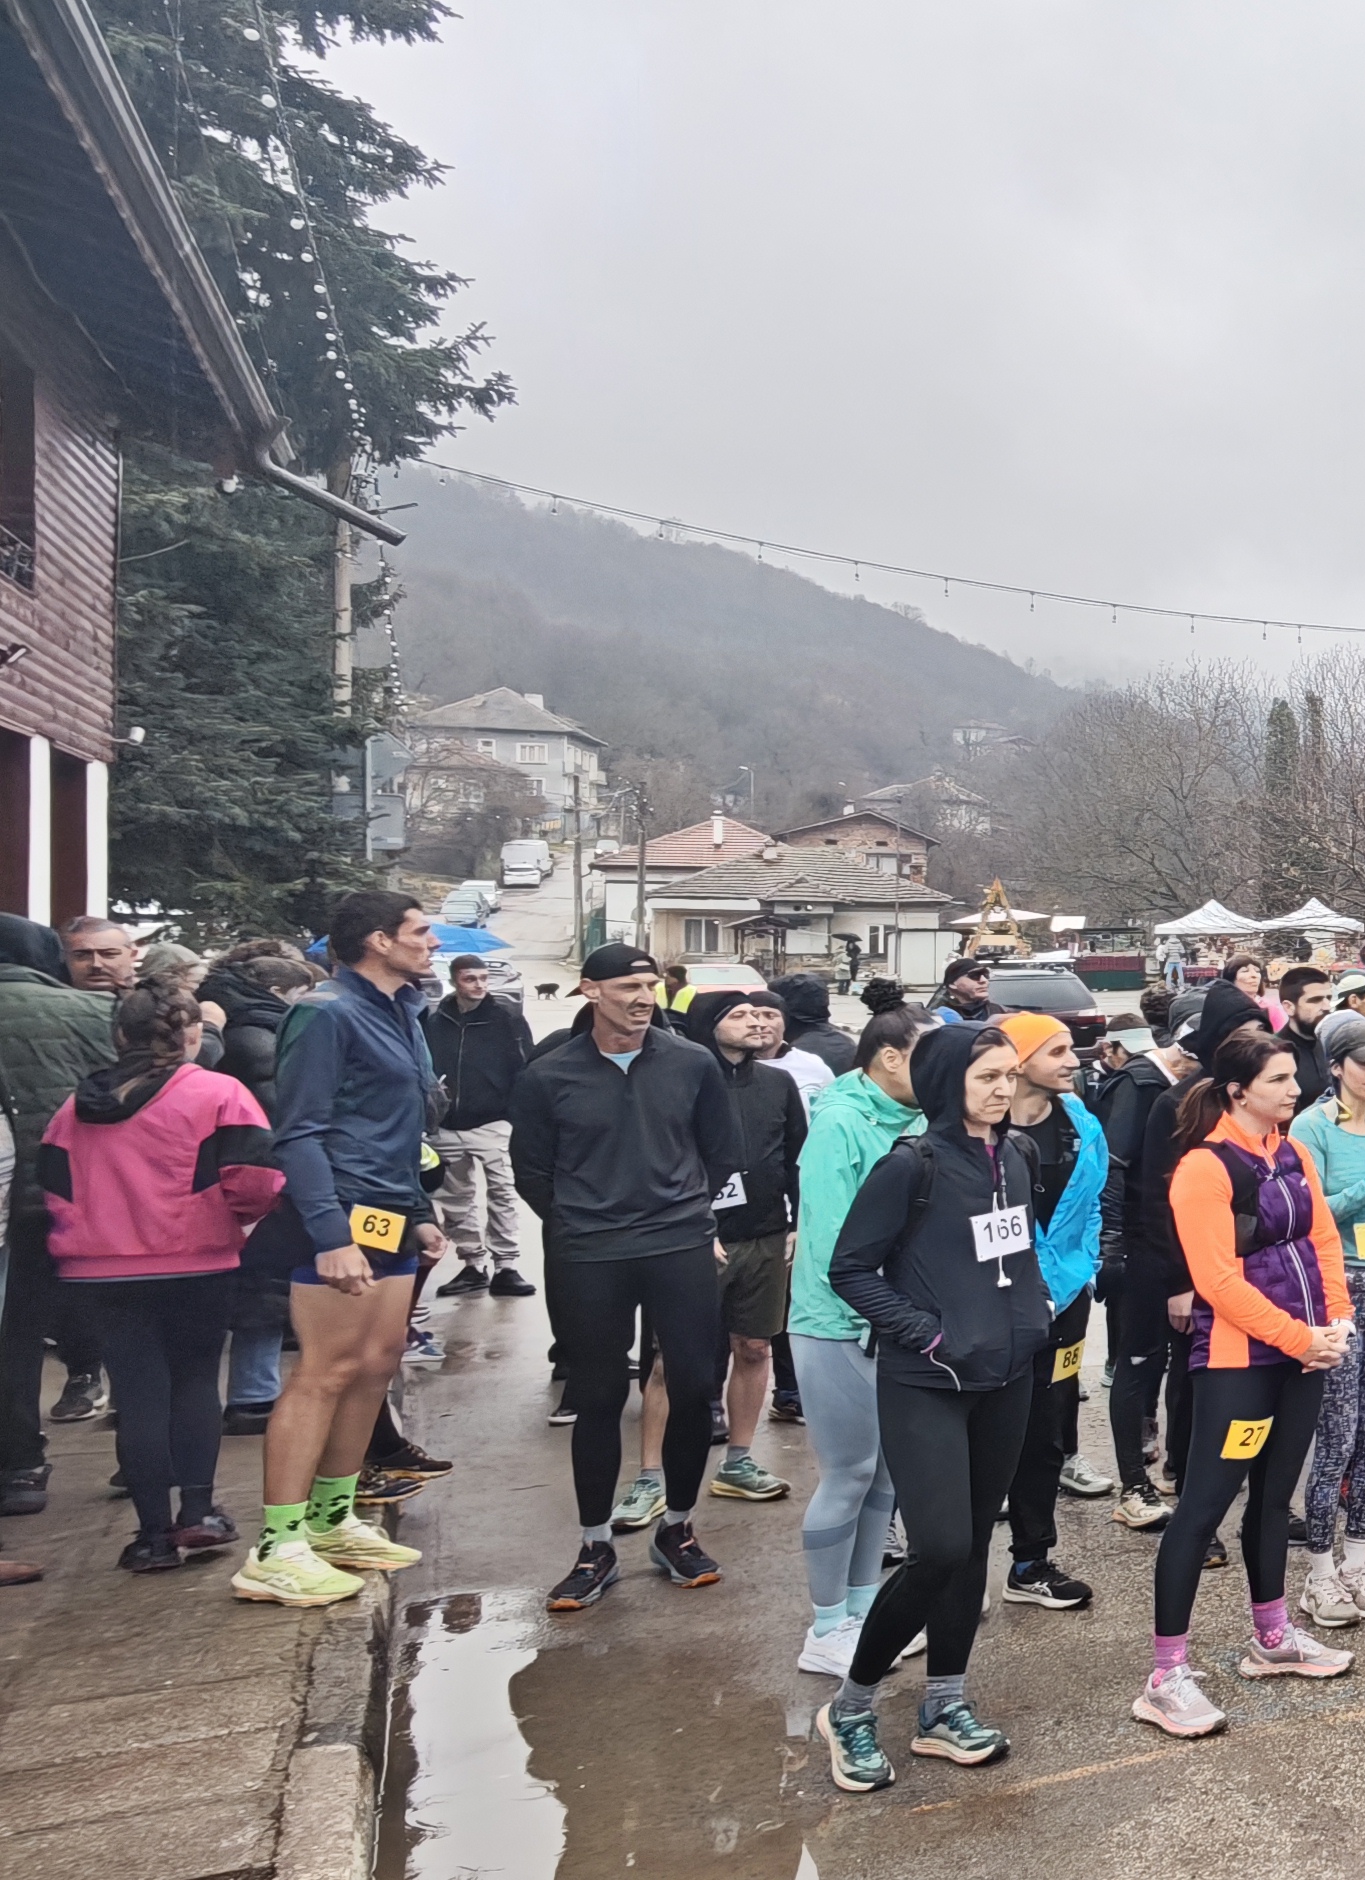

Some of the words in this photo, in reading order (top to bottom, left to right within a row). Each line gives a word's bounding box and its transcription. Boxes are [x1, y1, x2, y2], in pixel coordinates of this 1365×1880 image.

[363, 1215, 391, 1237] 63
[983, 1216, 1022, 1242] 166
[1239, 1426, 1265, 1447] 27
